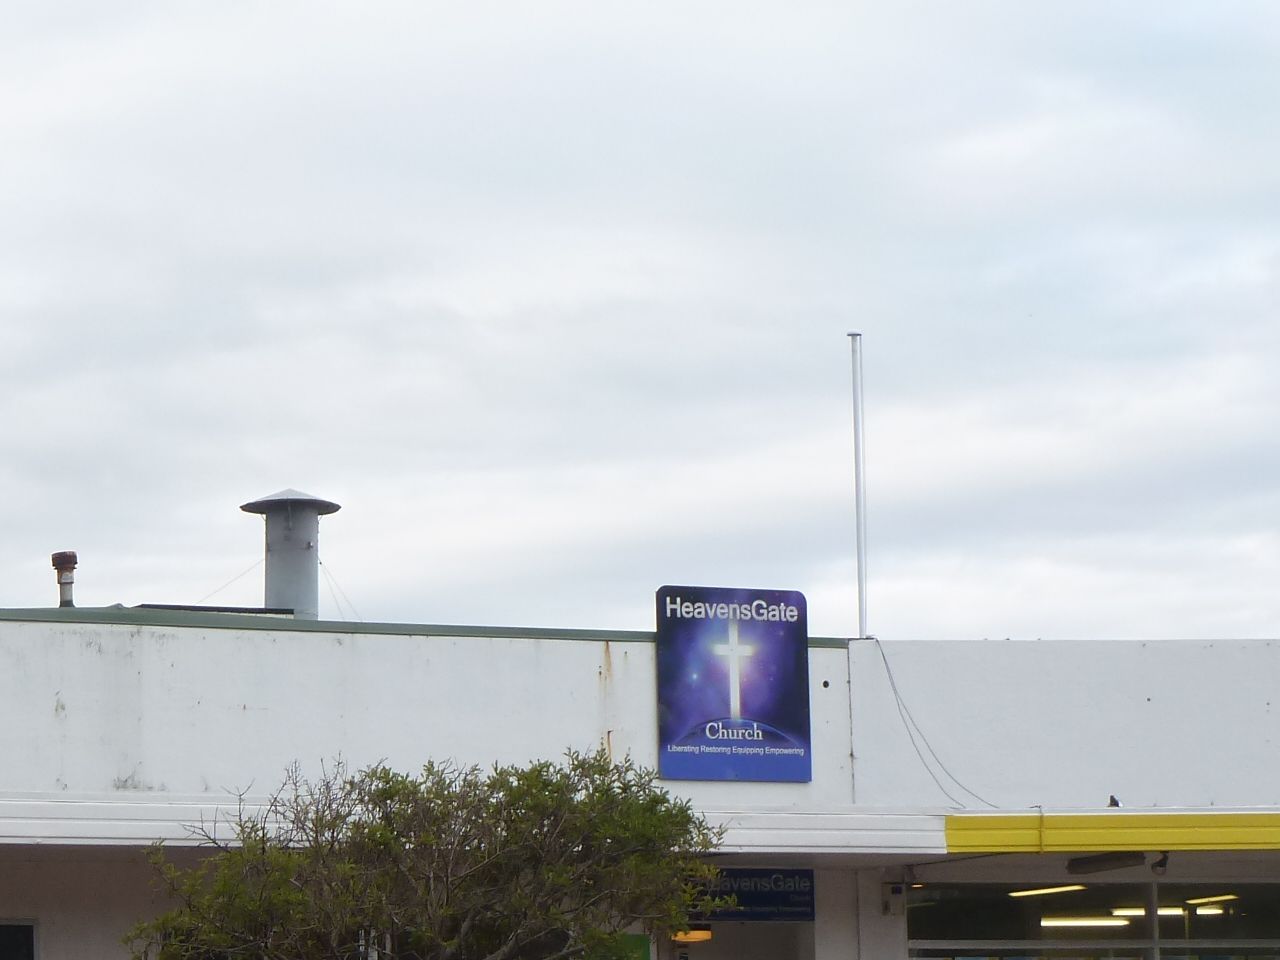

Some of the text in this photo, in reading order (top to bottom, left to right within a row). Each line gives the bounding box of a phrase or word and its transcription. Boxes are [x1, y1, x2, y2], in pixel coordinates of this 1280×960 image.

[666, 596, 799, 622] HeavensGate
[705, 722, 763, 740] Church
[667, 744, 805, 757] Liberating Restoring Equipping Empowering
